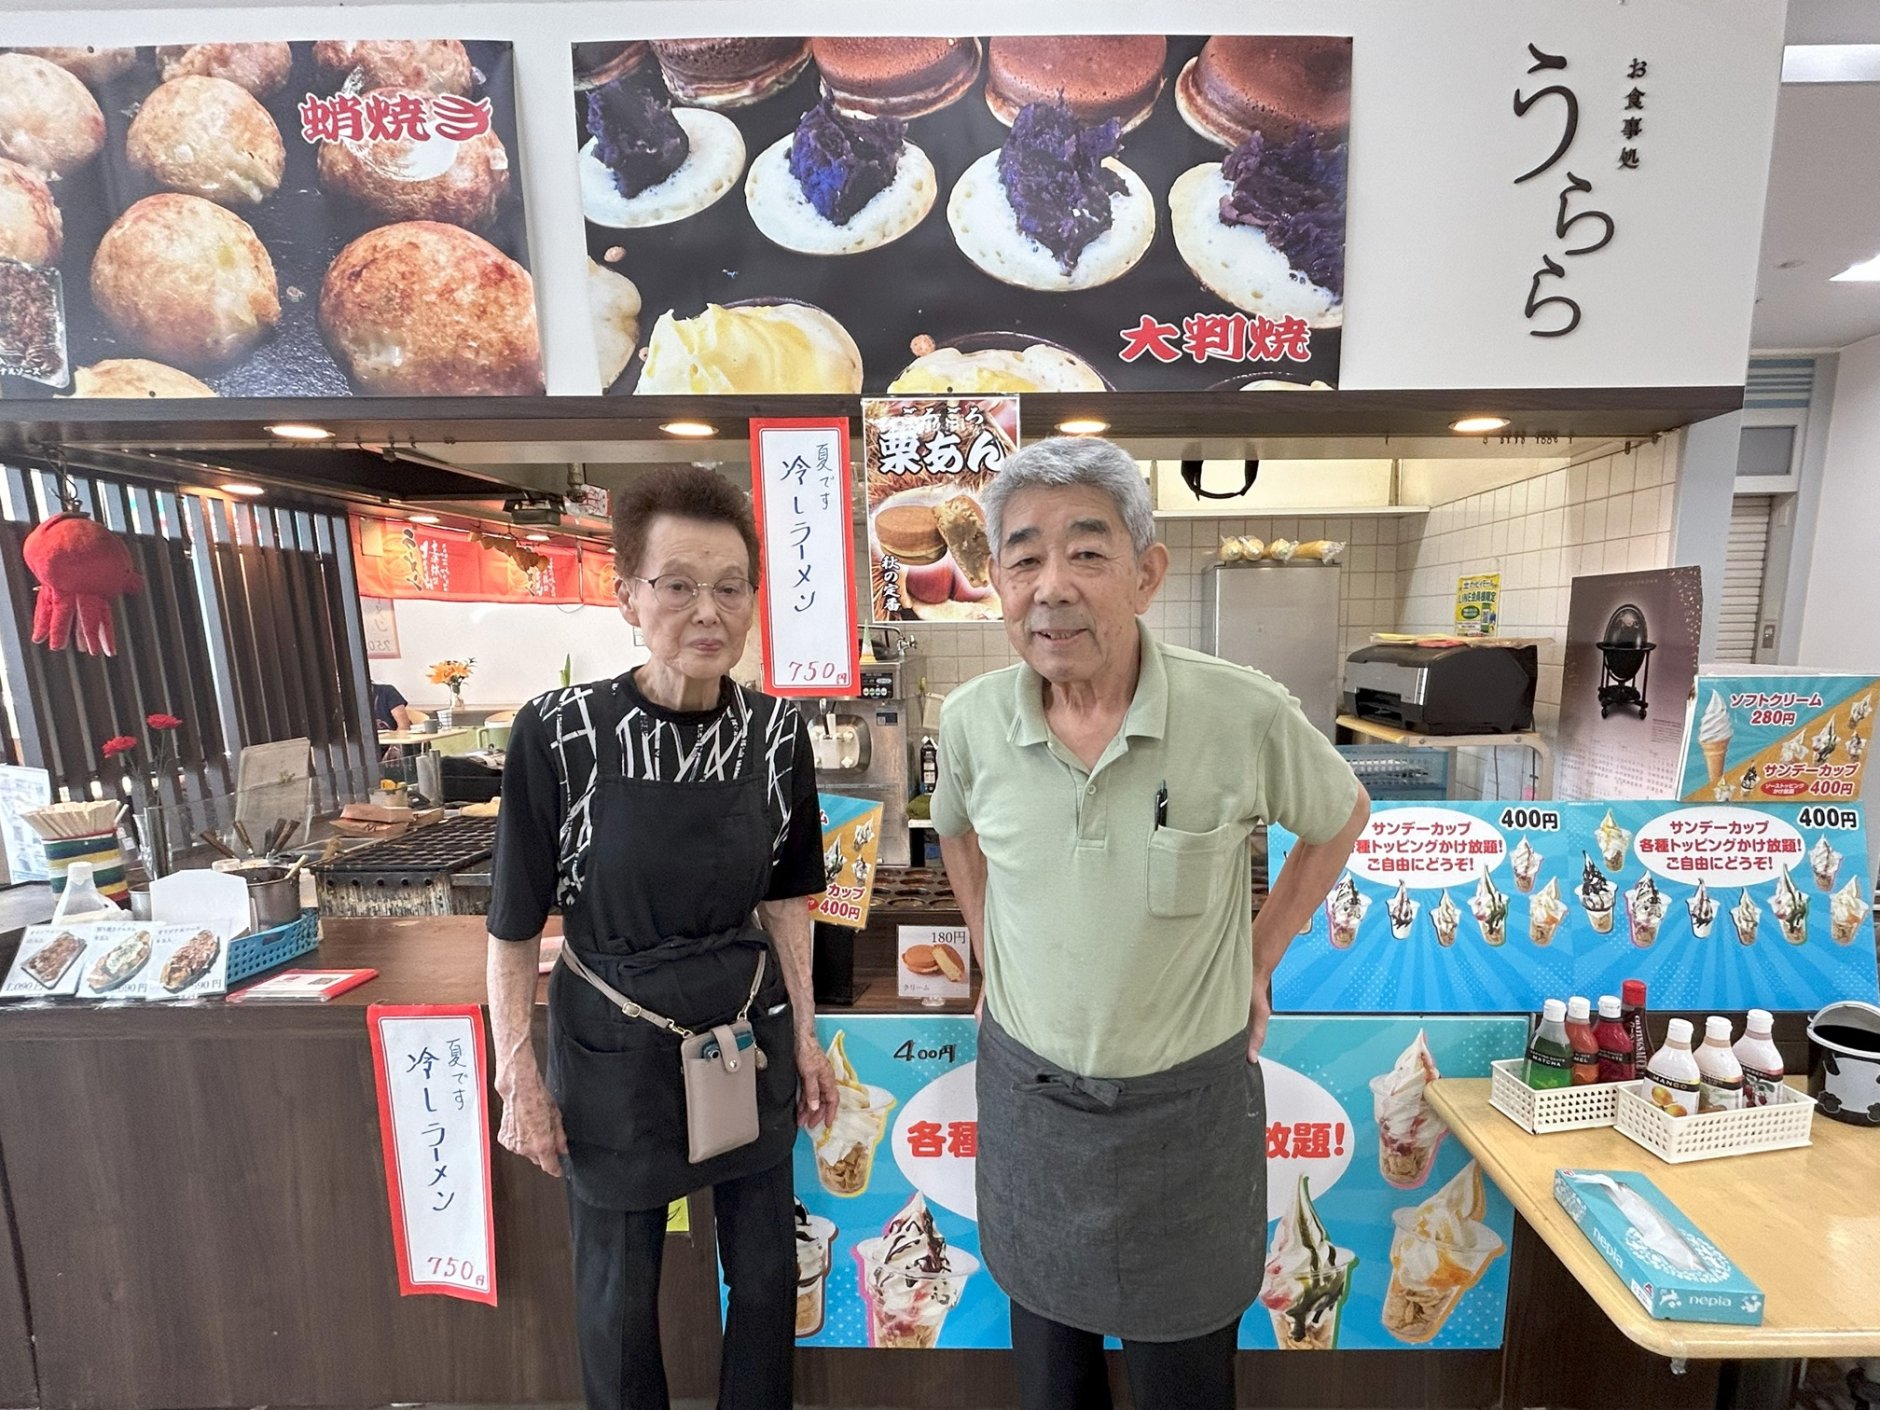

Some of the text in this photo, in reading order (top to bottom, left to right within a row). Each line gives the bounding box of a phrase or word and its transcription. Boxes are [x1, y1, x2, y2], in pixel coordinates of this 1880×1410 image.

[299, 93, 493, 143] 蛸焼き
[1617, 58, 1647, 169] お食事処
[1513, 42, 1615, 338] うらら
[1119, 312, 1312, 363] 大判焼
[878, 430, 1003, 475] 栗あん
[815, 443, 835, 510] 夏です
[780, 455, 816, 612] 冷しラーメン
[882, 555, 901, 611] 秋の定番
[788, 660, 848, 686] 750円
[1731, 693, 1822, 707] ソフトクリーム
[1752, 711, 1796, 725] 280円
[1764, 763, 1858, 777] サンデーカップ
[1810, 781, 1853, 795] 400円
[1501, 810, 1558, 829] 400円
[1669, 821, 1769, 834] サンデーカップ
[1799, 808, 1857, 828] 400円
[1372, 822, 1471, 836] サンデーカップ
[1351, 839, 1503, 854] 種トッピングかけ放題!
[1639, 838, 1801, 852] 各種トッピングかけ放題!
[1367, 857, 1474, 871] ご自由にどうぞ!
[1666, 857, 1773, 870] ご自由にどうぞ!
[827, 883, 865, 900] カップ
[820, 899, 861, 919] 400円
[932, 931, 966, 944] 180円
[893, 1039, 957, 1063] 400円
[1532, 1055, 1561, 1067] MATCHA
[446, 1038, 468, 1111] 夏です
[1653, 1075, 1688, 1090] MANGO
[406, 1046, 455, 1212] 冷しラーメン
[907, 1120, 1345, 1158] 各種 放題!
[1593, 1226, 1624, 1270] nepia
[426, 1256, 486, 1287] 750円
[1689, 1294, 1732, 1307] nepia
